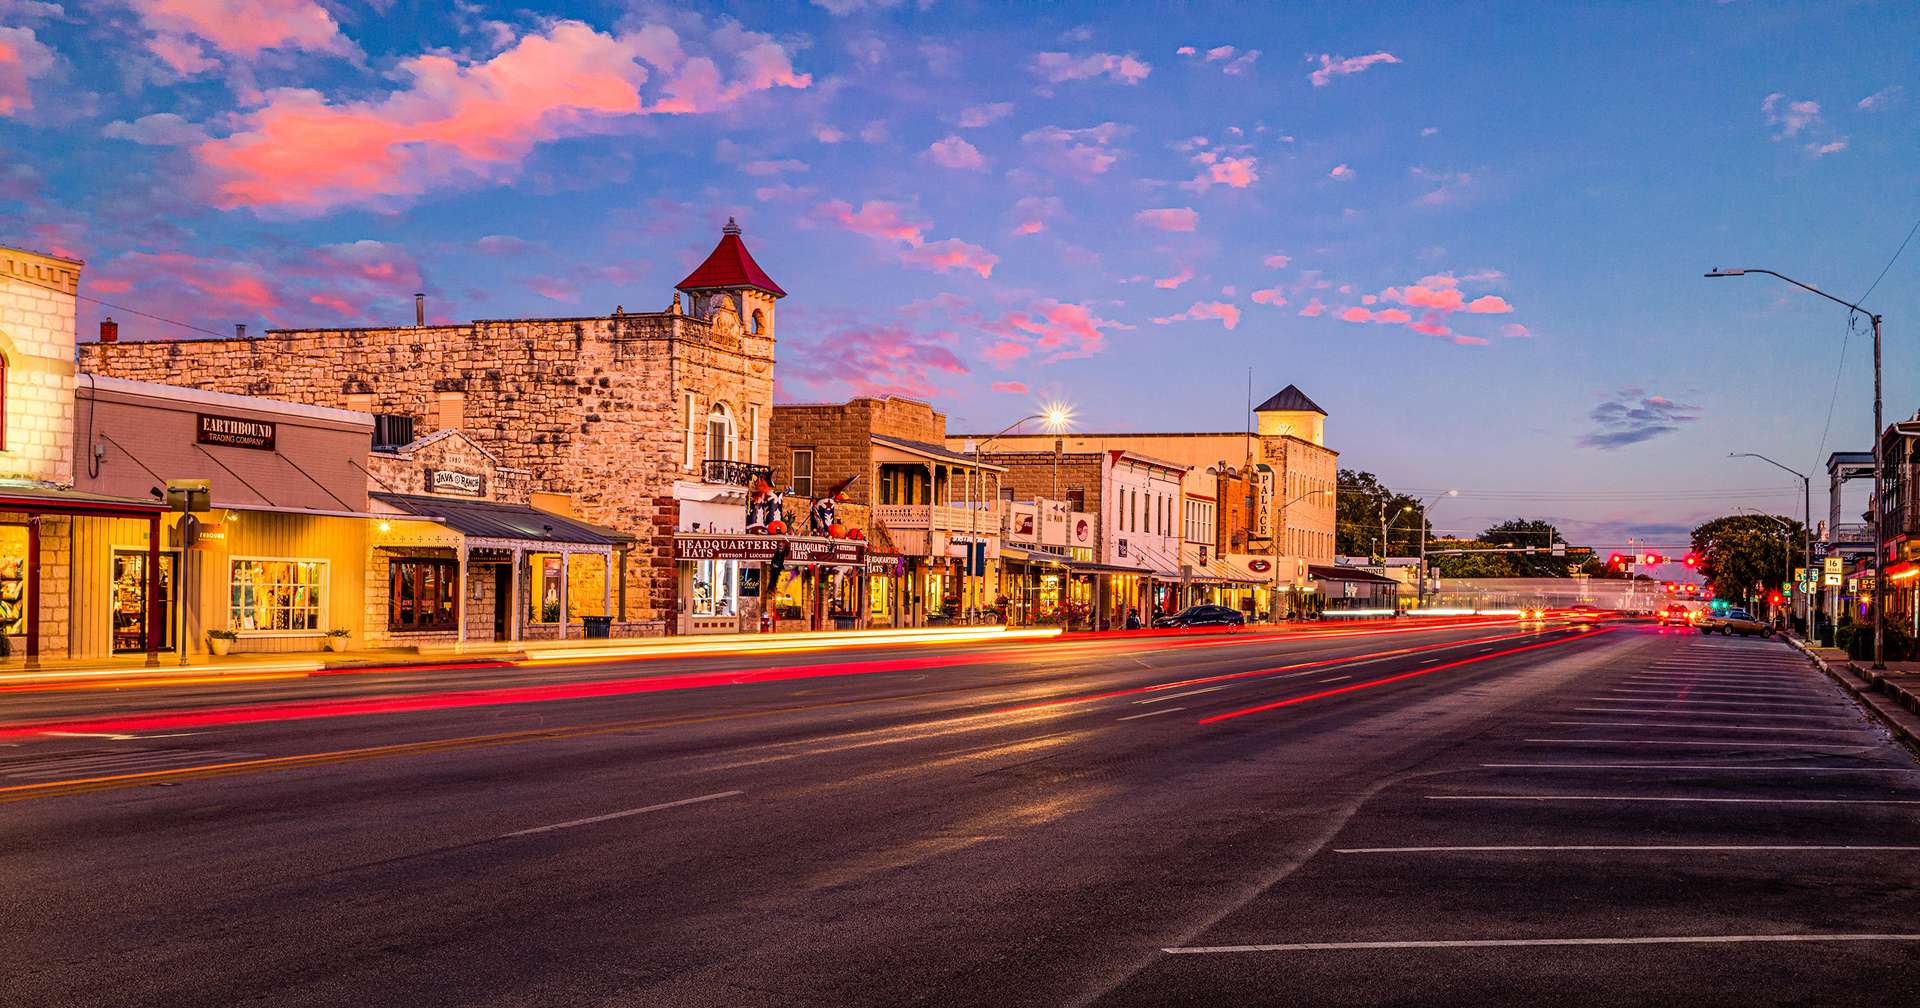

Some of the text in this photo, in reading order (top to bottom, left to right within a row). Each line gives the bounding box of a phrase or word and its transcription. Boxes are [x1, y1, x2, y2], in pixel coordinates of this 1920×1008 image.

[203, 417, 272, 438] EARTHBOUND
[209, 432, 265, 446] TRADING COMPANY
[436, 472, 479, 488] JAVA RANCH
[1259, 475, 1269, 536] PALACE
[677, 539, 778, 551] HEADQUARTERS
[790, 542, 836, 554] HEADQUARTE
[682, 548, 714, 558] HATS
[792, 550, 808, 560] HATS
[864, 555, 899, 564] HEADQUARTERS
[1829, 559, 1838, 567] 16
[867, 562, 883, 574] HATS
